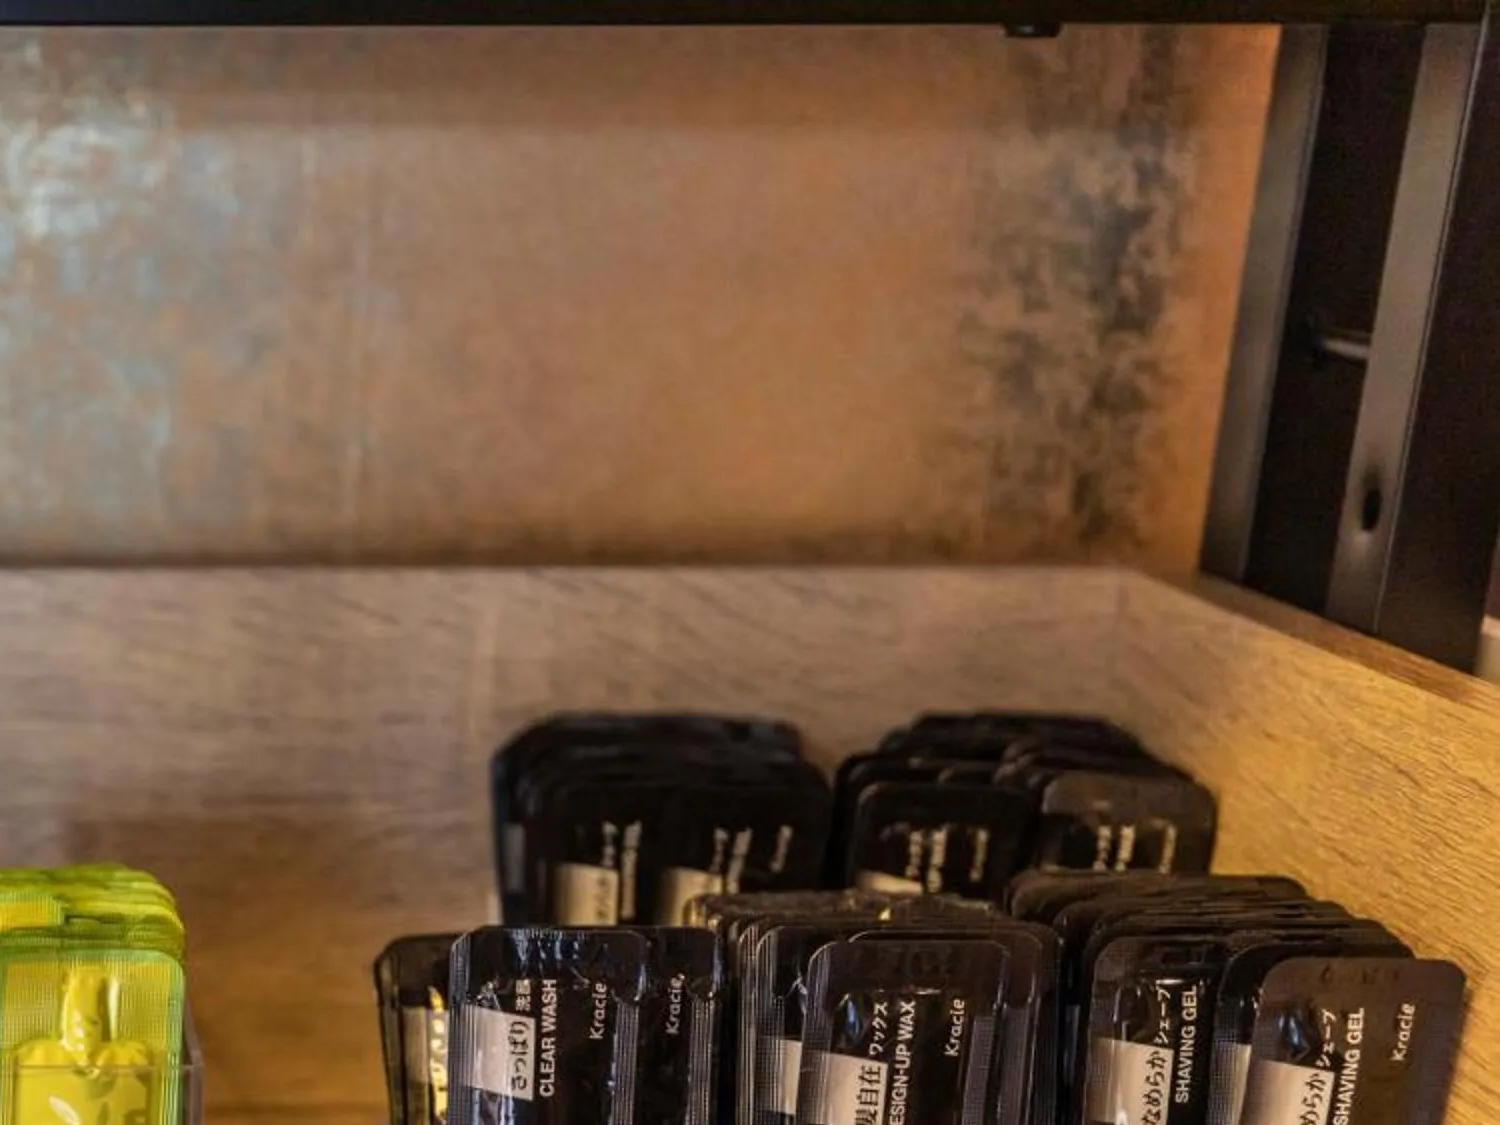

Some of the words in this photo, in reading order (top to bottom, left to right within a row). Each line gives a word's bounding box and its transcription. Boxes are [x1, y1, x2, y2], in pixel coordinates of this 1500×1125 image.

[541, 979, 557, 1033] WASH
[588, 982, 607, 1040] Kracie
[665, 977, 683, 1035] Kracie
[868, 1002, 888, 1056] ワックス
[897, 1000, 916, 1041] WAX
[943, 999, 965, 1057] Kracie
[1181, 985, 1197, 1021] GEL
[1346, 1007, 1365, 1045] GEL
[507, 1020, 530, 1091] さっぱり
[1391, 1003, 1415, 1062] Kracie
[539, 1037, 556, 1098] CLEAR
[1175, 1025, 1196, 1104] SHAVING
